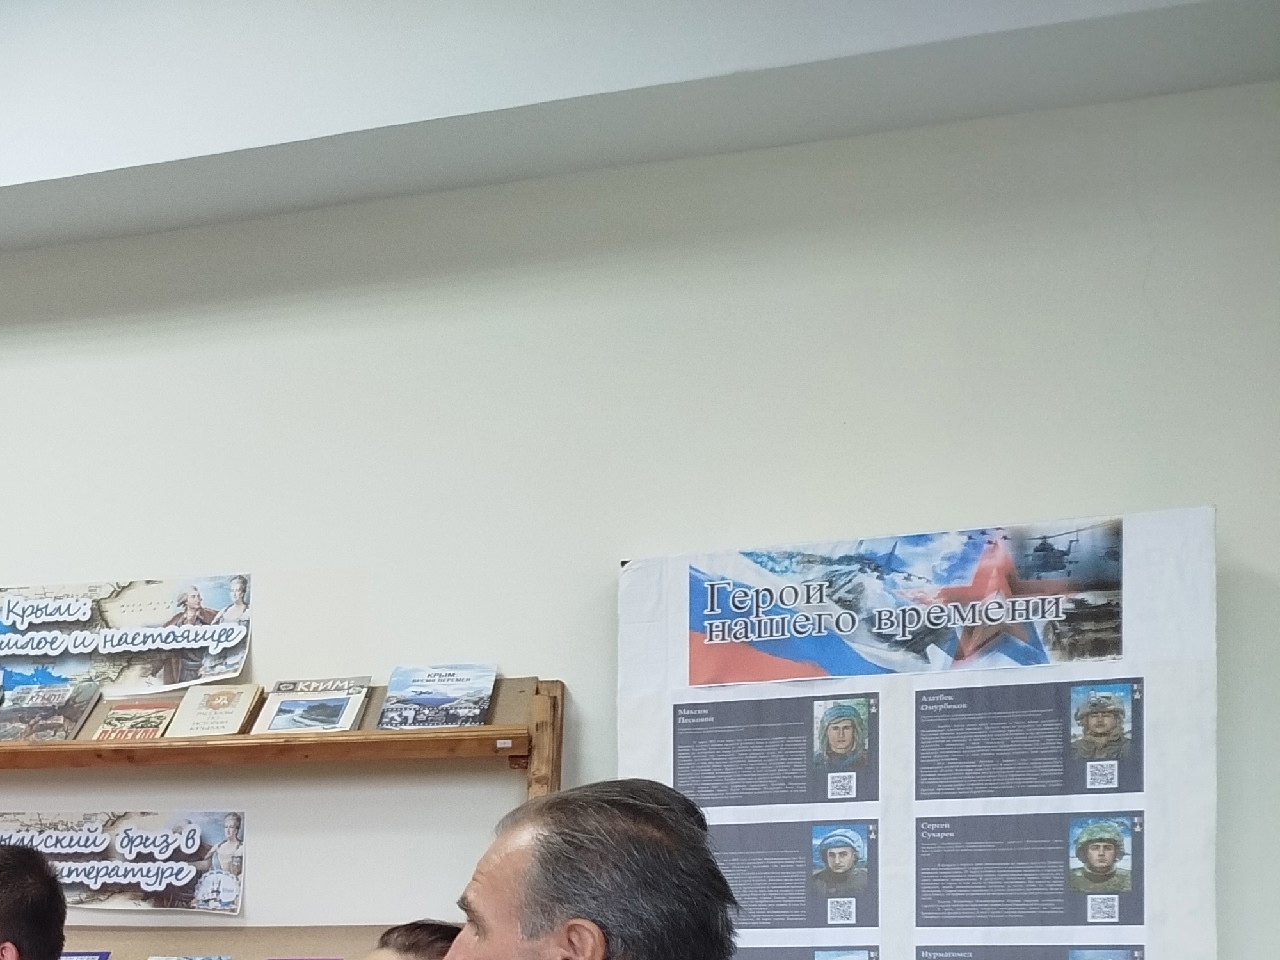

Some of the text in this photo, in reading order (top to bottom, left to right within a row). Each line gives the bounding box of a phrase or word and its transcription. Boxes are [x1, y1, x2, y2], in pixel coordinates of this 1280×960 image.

[5, 599, 89, 624] Крым:
[704, 580, 829, 618] Герои
[704, 595, 1066, 643] нашего времени
[72, 635, 94, 649] и
[103, 625, 244, 651] настоящее
[120, 828, 180, 854] бриз
[184, 828, 197, 852] в
[61, 865, 191, 886] итературе
